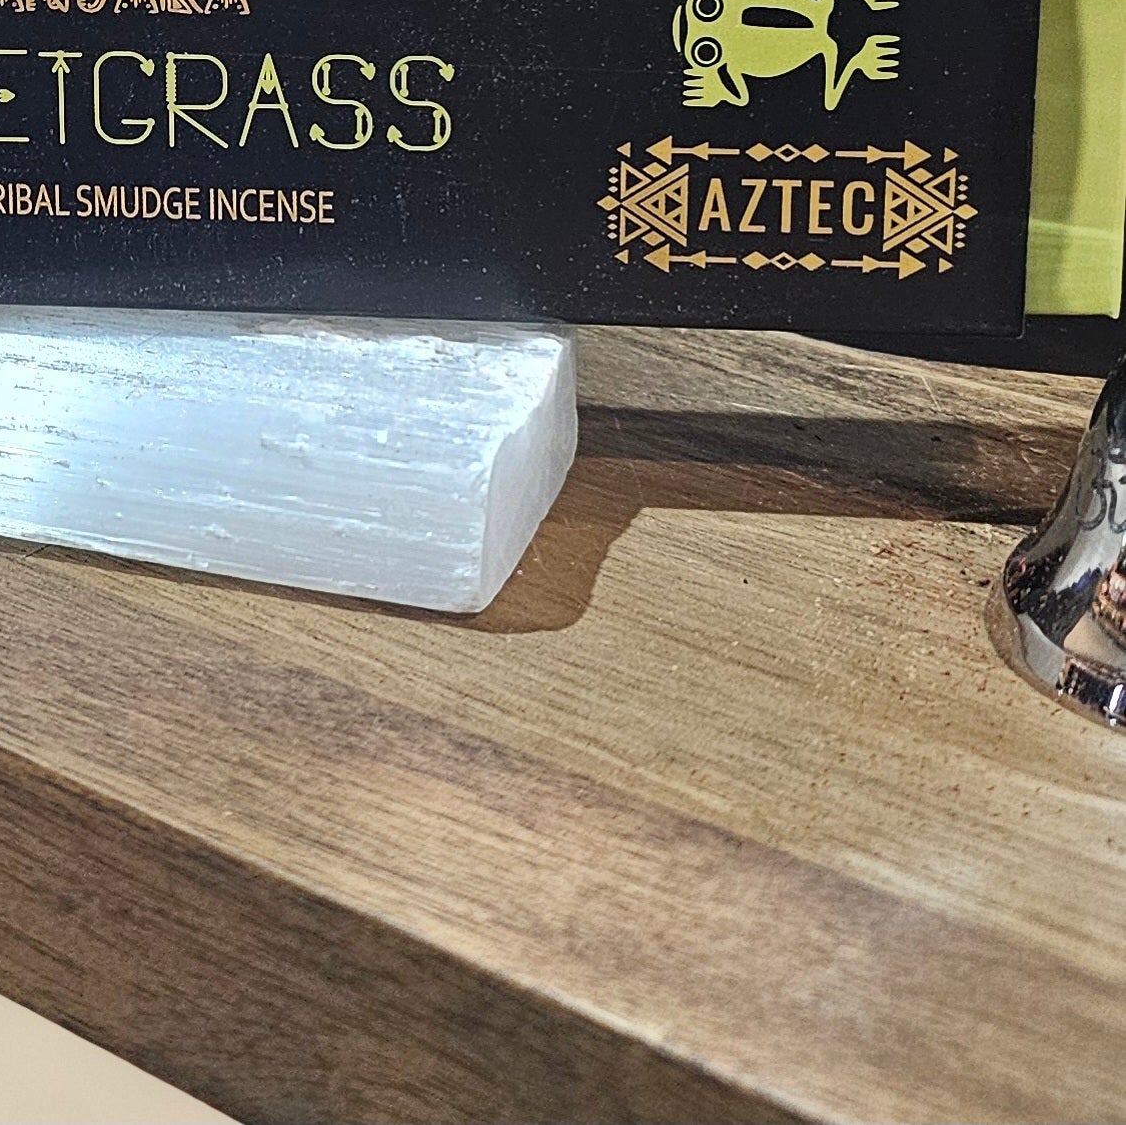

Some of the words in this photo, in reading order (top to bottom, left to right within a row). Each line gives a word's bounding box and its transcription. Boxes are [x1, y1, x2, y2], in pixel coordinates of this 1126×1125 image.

[76, 184, 201, 221] SMUDGE
[209, 188, 335, 224] INCENSE
[698, 178, 875, 236] AZTEC
